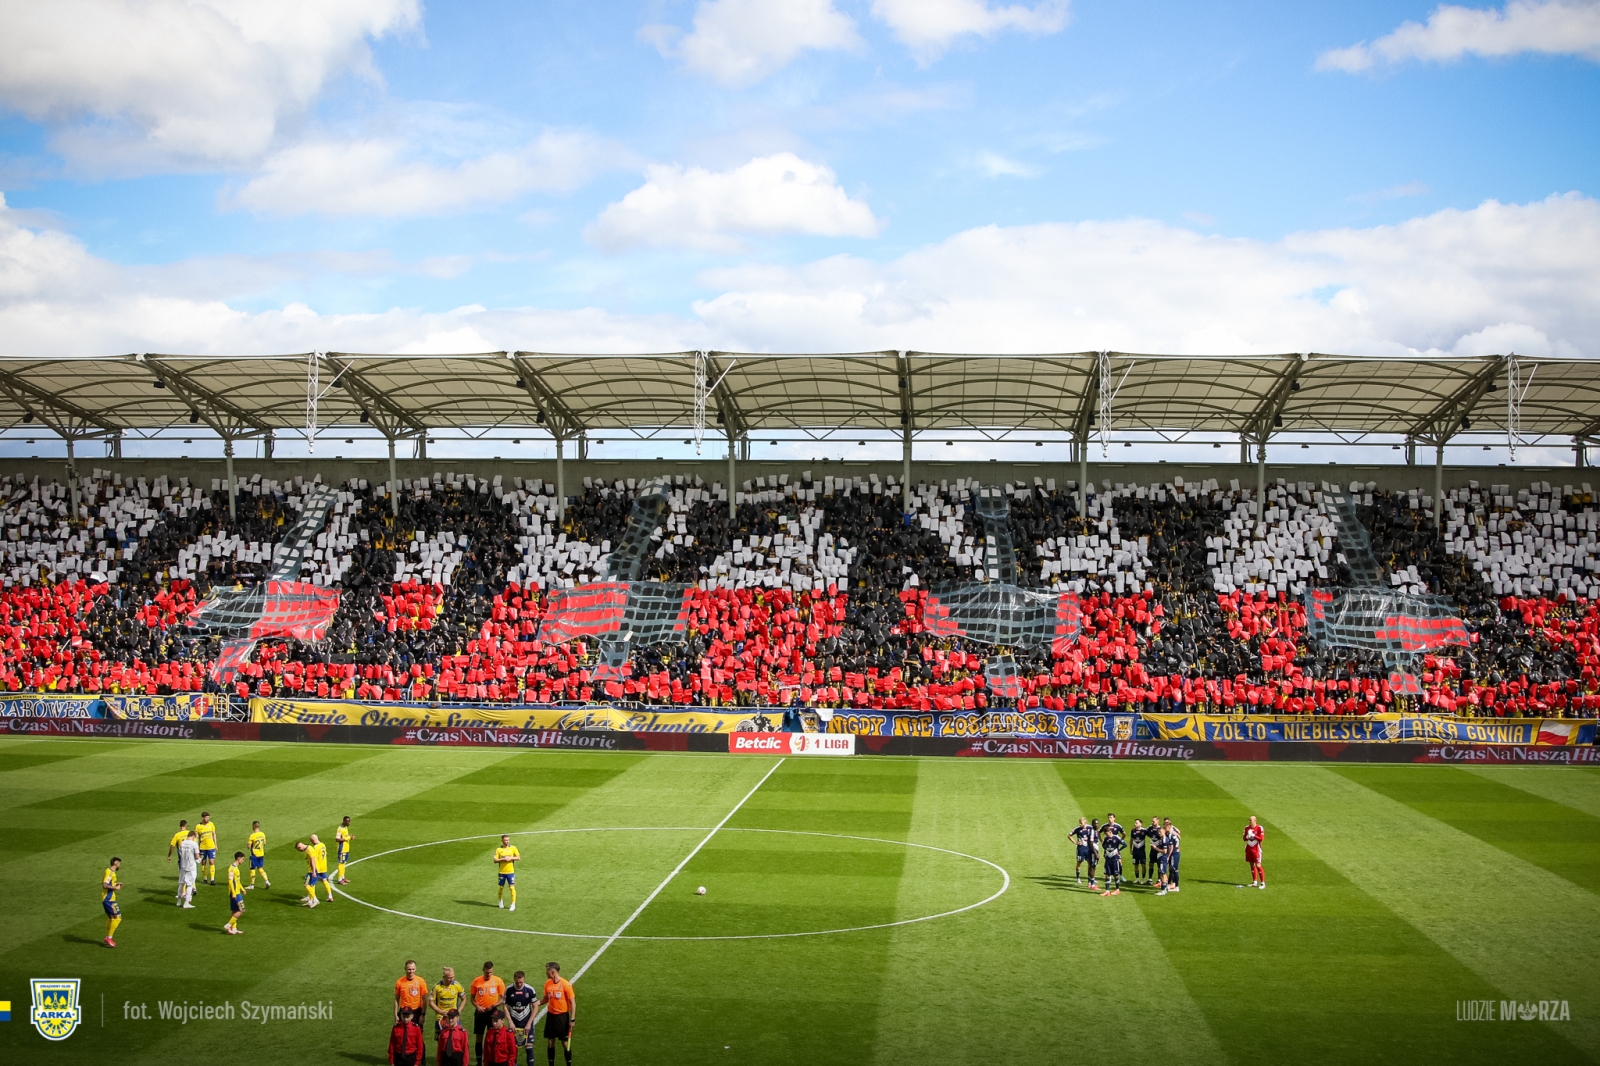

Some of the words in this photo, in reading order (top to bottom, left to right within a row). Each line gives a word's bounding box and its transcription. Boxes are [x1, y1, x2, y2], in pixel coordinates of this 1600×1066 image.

[1284, 723, 1373, 740] NIEBIESCY
[1412, 720, 1458, 738] ARKA
[1466, 725, 1524, 743] GDYNIA
[735, 737, 782, 749] Betclic
[814, 739, 820, 748] 1
[824, 739, 849, 749] LIGA
